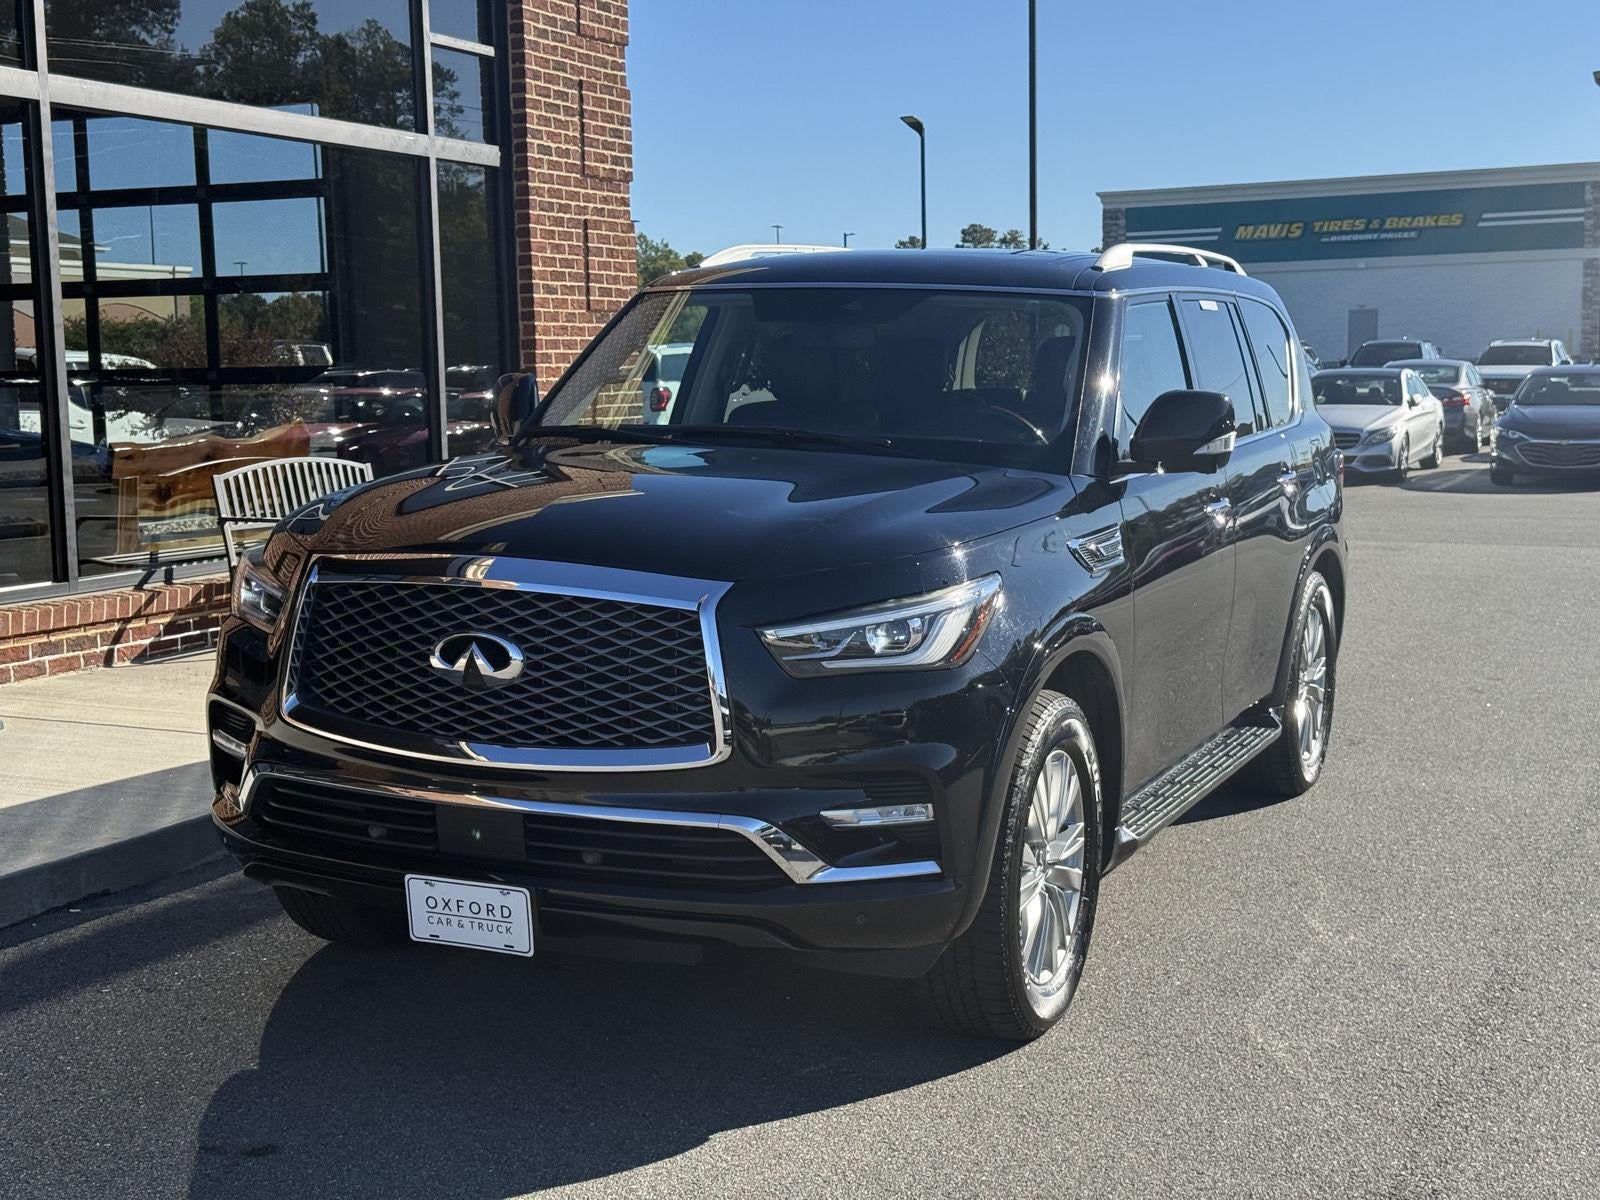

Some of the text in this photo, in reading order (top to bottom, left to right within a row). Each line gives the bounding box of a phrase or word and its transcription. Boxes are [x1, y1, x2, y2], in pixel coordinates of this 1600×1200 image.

[1235, 222, 1304, 240] MAVIS
[1312, 218, 1367, 232] TIRES
[1369, 219, 1381, 229] &
[1384, 214, 1463, 229] BRAKES
[1330, 233, 1378, 241] DISCOUNT
[425, 896, 512, 919] OXFORD
[427, 915, 513, 935] CAR & TRUCK
